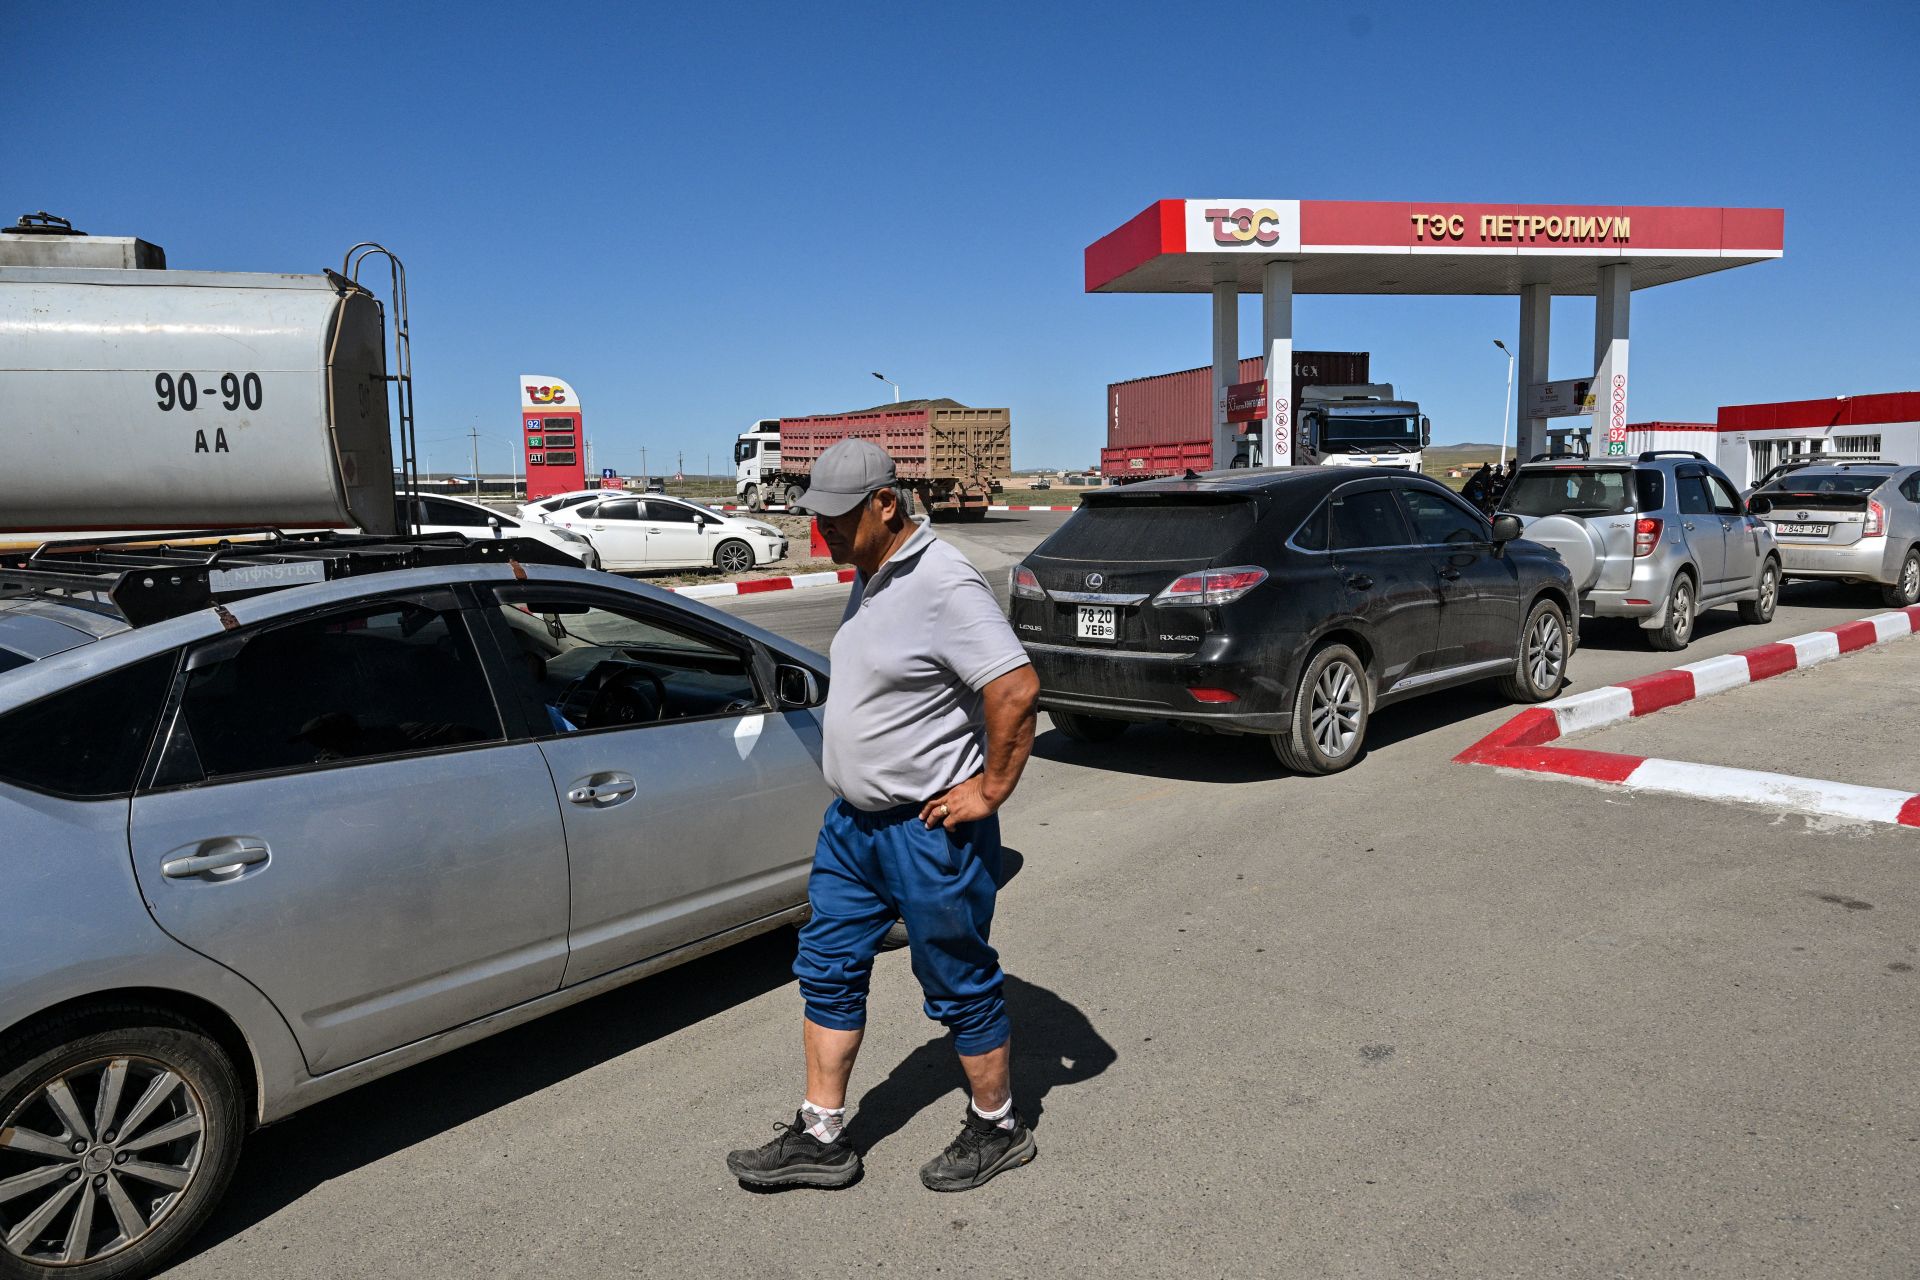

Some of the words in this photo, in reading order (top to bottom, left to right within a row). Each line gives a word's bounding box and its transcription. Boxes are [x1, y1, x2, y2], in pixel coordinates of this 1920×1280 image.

[1411, 213, 1465, 240] ТЭС
[1479, 214, 1631, 242] ПЕТРОЛИУМ
[154, 371, 263, 412] 90-90
[527, 420, 540, 429] 92
[1611, 429, 1625, 442] 92
[1610, 444, 1624, 455] 92
[1019, 623, 1042, 631] LEXUS
